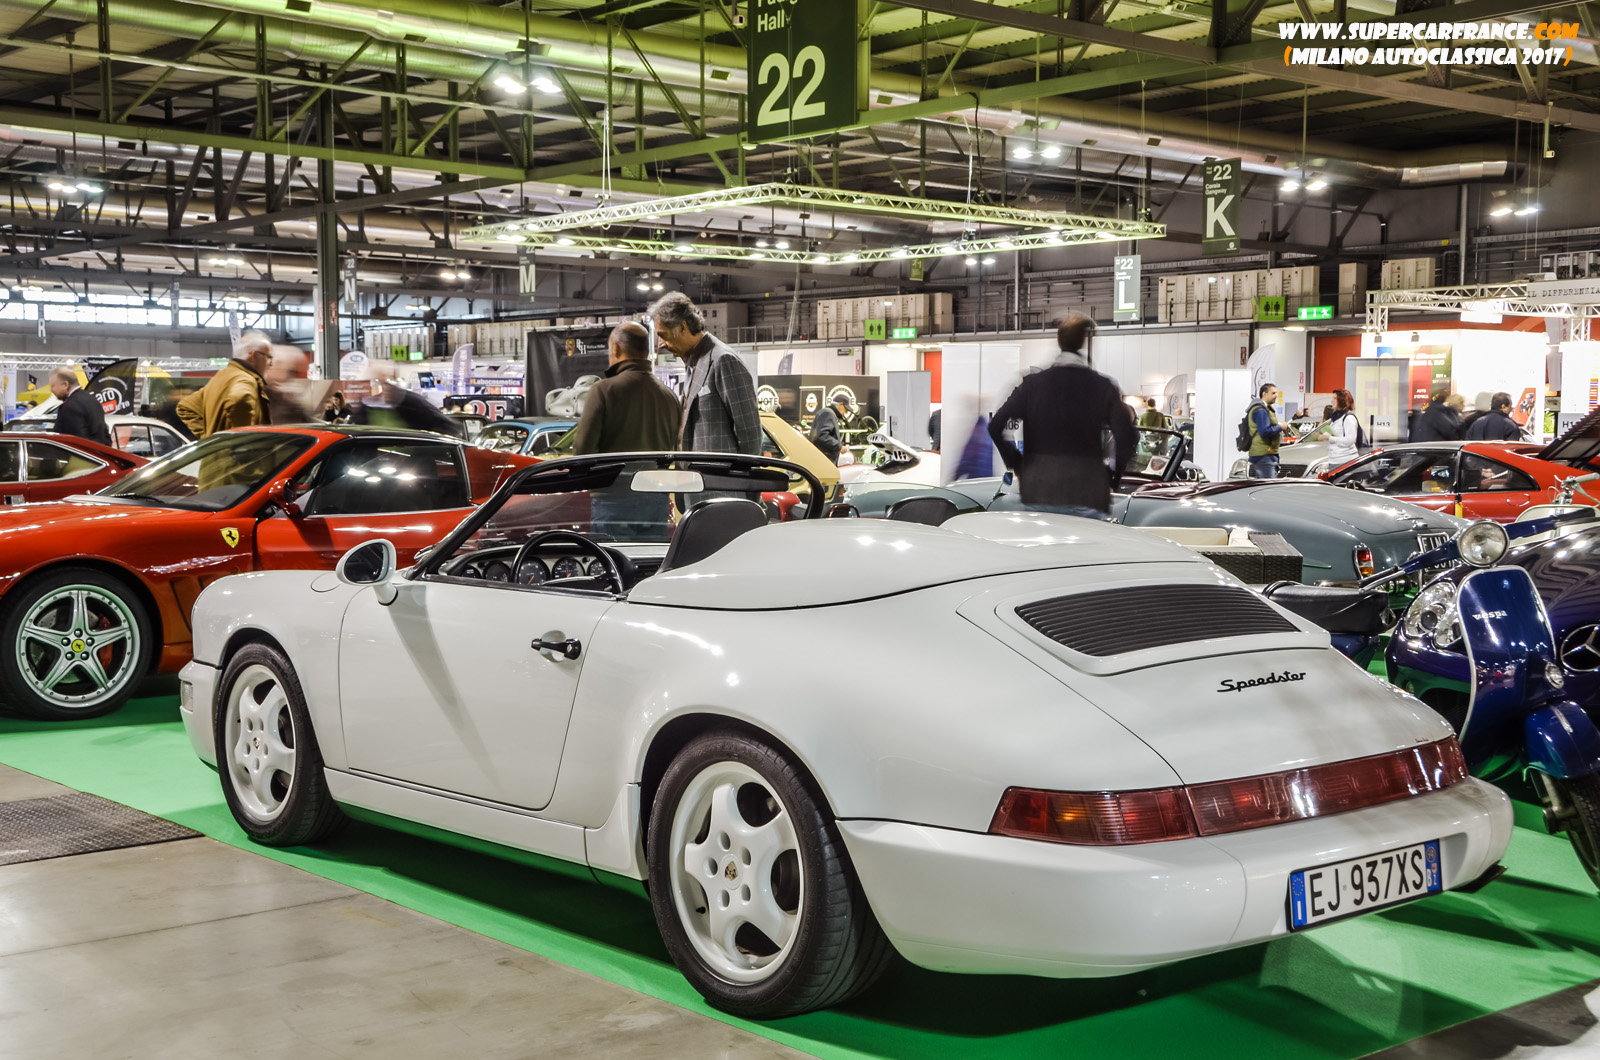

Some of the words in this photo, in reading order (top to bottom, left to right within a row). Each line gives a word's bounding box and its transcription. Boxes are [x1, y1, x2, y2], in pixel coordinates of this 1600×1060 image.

[757, 9, 785, 33] Hall
[757, 45, 826, 126] 22
[1213, 163, 1232, 181] 22
[1206, 194, 1236, 239] K
[1120, 257, 1134, 270] 22
[344, 277, 356, 302] N
[519, 264, 536, 294] M
[1118, 280, 1136, 310] L
[38, 318, 46, 338] R
[1472, 610, 1508, 620] vespa
[1217, 670, 1307, 693] Speedster
[1309, 868, 1341, 917] EJ
[1351, 849, 1425, 906] 937XS
